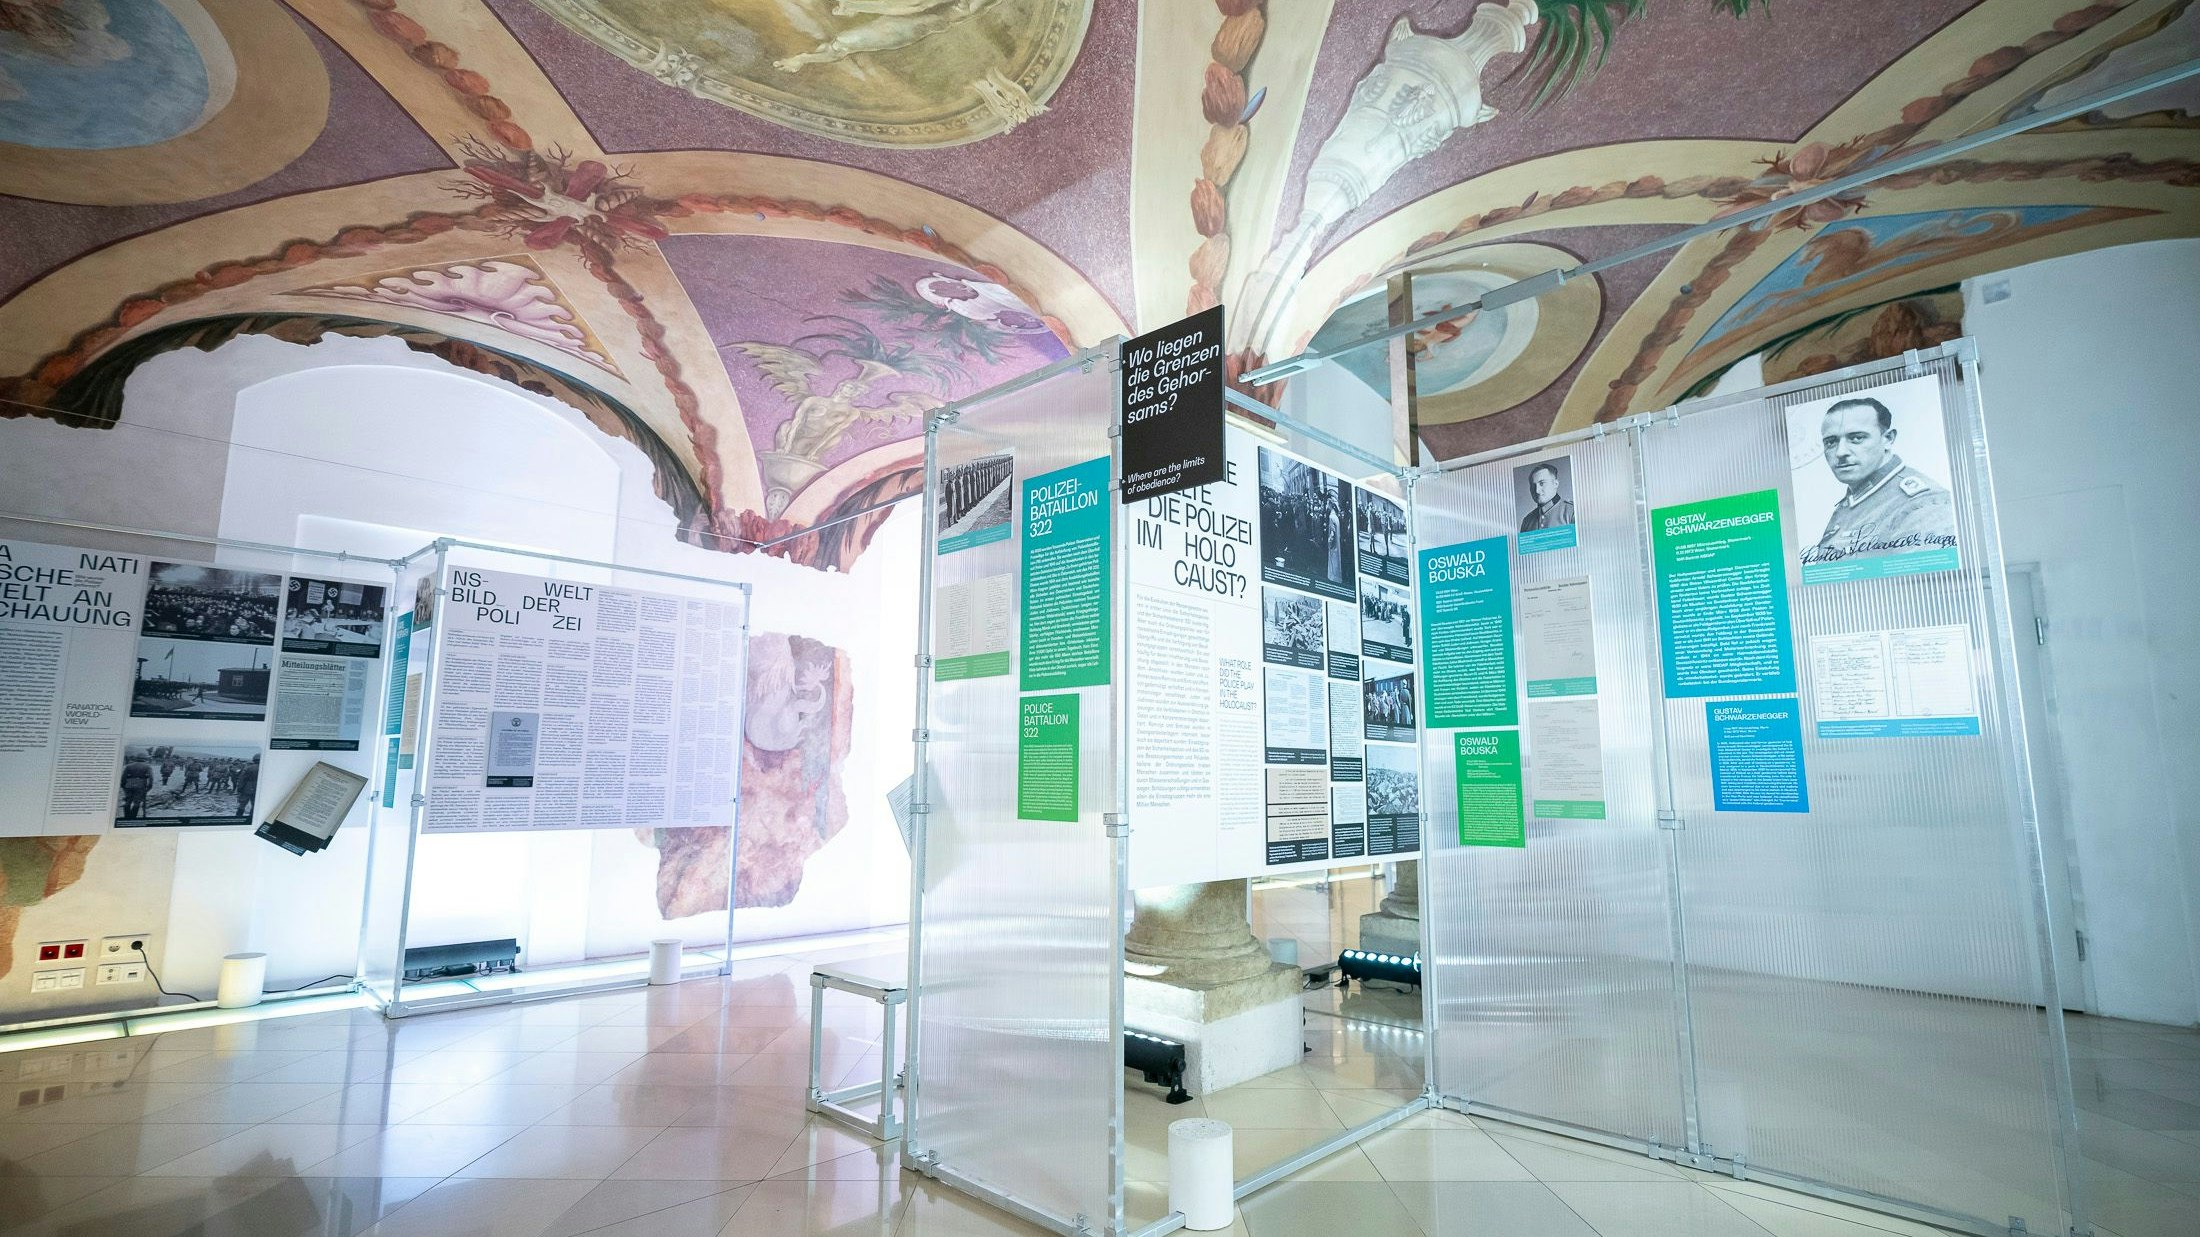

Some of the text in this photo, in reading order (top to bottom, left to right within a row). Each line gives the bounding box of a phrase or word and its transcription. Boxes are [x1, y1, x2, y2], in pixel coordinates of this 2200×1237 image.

[1129, 331, 1203, 368] Wo liegen
[1128, 344, 1220, 386] die Grenzen
[1128, 367, 1212, 406] des Gehor-
[1127, 392, 1178, 424] sams?
[1127, 456, 1206, 484] Where are the limits
[1031, 478, 1083, 505] POLIZEI-
[1127, 473, 1181, 495] of obedience?
[1031, 489, 1098, 521] BATAILLON
[1030, 519, 1053, 537] 322
[1148, 495, 1252, 546] DIE POLIZEI
[1665, 512, 1706, 527] GUSTAV
[1665, 511, 1774, 536] SCHWARZENEGGER
[1137, 518, 1236, 568] IM HOLO
[80, 553, 139, 575] NATI
[1428, 550, 1486, 570] OSWALD
[0, 563, 75, 586] SCHE
[1174, 559, 1247, 599] CAUST?
[1429, 563, 1486, 584] BOUSKA
[0, 583, 112, 608] ELT AN
[453, 570, 593, 601] NS- WELT
[522, 595, 560, 613] DER
[477, 607, 582, 631] POLI ZEI
[66, 703, 115, 711] FANATICAL
[1024, 703, 1053, 714] POLICE
[1713, 707, 1743, 715] GUSTAV
[1714, 712, 1789, 722] SCHWARZENEGGER
[1024, 714, 1069, 726] BATTALION
[1023, 727, 1039, 738] 322
[1460, 736, 1499, 746] OSWALD
[1460, 746, 1498, 756] BOUSKA
